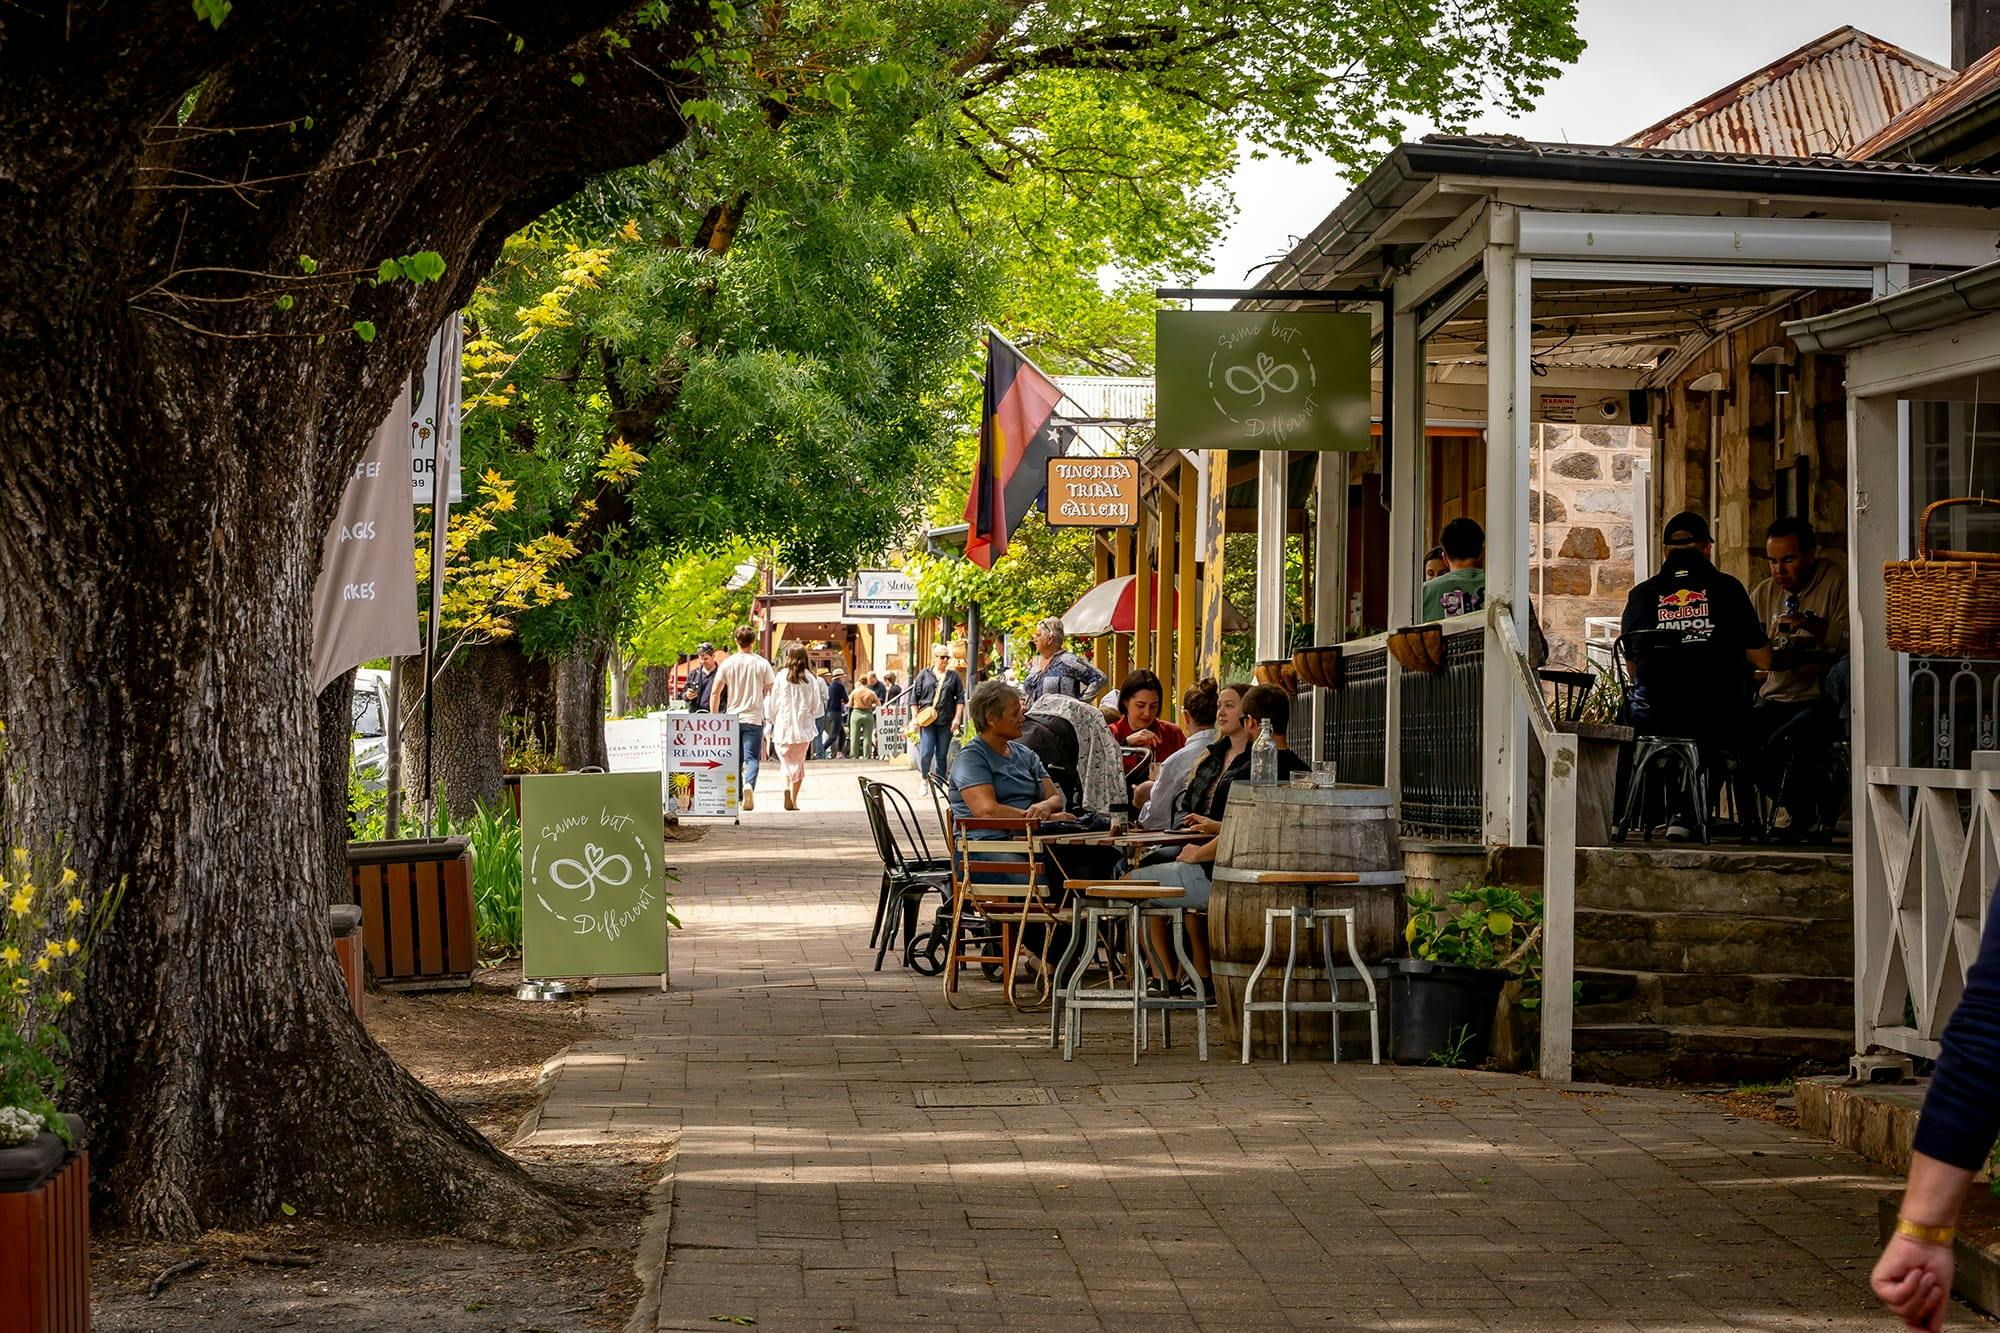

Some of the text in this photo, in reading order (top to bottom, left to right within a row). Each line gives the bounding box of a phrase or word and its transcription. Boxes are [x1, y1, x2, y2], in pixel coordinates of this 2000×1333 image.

[1218, 318, 1303, 349] Same but
[1244, 393, 1320, 445] Different
[1055, 462, 1132, 480] TINERIBA
[1066, 480, 1123, 499] TRIBAL
[1060, 499, 1130, 524] GALLERY
[1656, 618, 1716, 631] AMPOL
[881, 708, 905, 716] FREE
[671, 719, 734, 731] TAROT
[673, 733, 732, 746] & Palm
[673, 748, 733, 758] READINGS
[541, 806, 635, 841] Same but
[573, 884, 656, 942] Different
